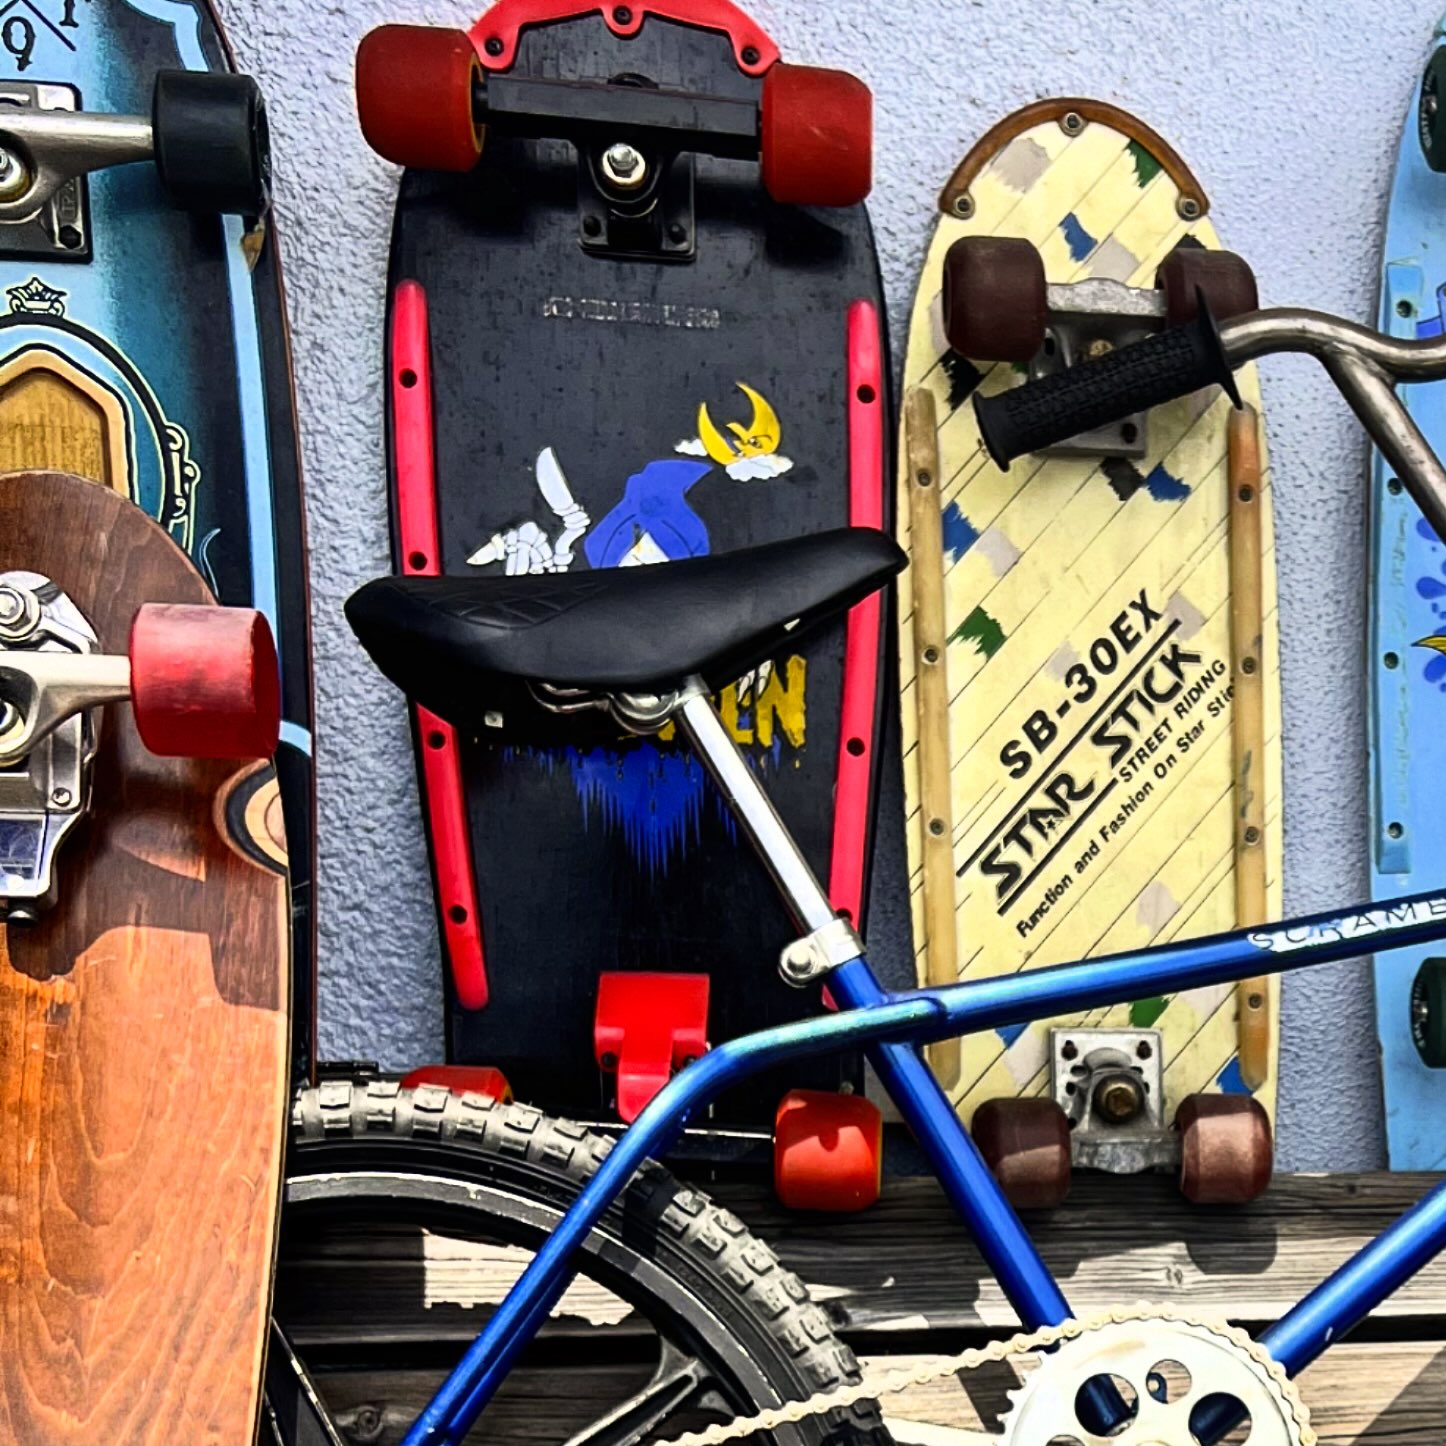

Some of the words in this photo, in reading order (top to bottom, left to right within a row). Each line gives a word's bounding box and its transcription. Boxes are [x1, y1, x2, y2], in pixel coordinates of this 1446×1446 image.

[979, 772, 1096, 900] STAR
[1090, 642, 1202, 769] STICK
[999, 588, 1163, 780] SB-30EX
[1118, 717, 1173, 784] STREET
[1176, 660, 1227, 718] RIDING
[1016, 873, 1074, 938] Function
[1074, 841, 1102, 875] and
[1100, 780, 1154, 842] Fashion
[1153, 754, 1178, 780] On
[1176, 721, 1207, 754] Star
[1207, 677, 1236, 718] Stic
